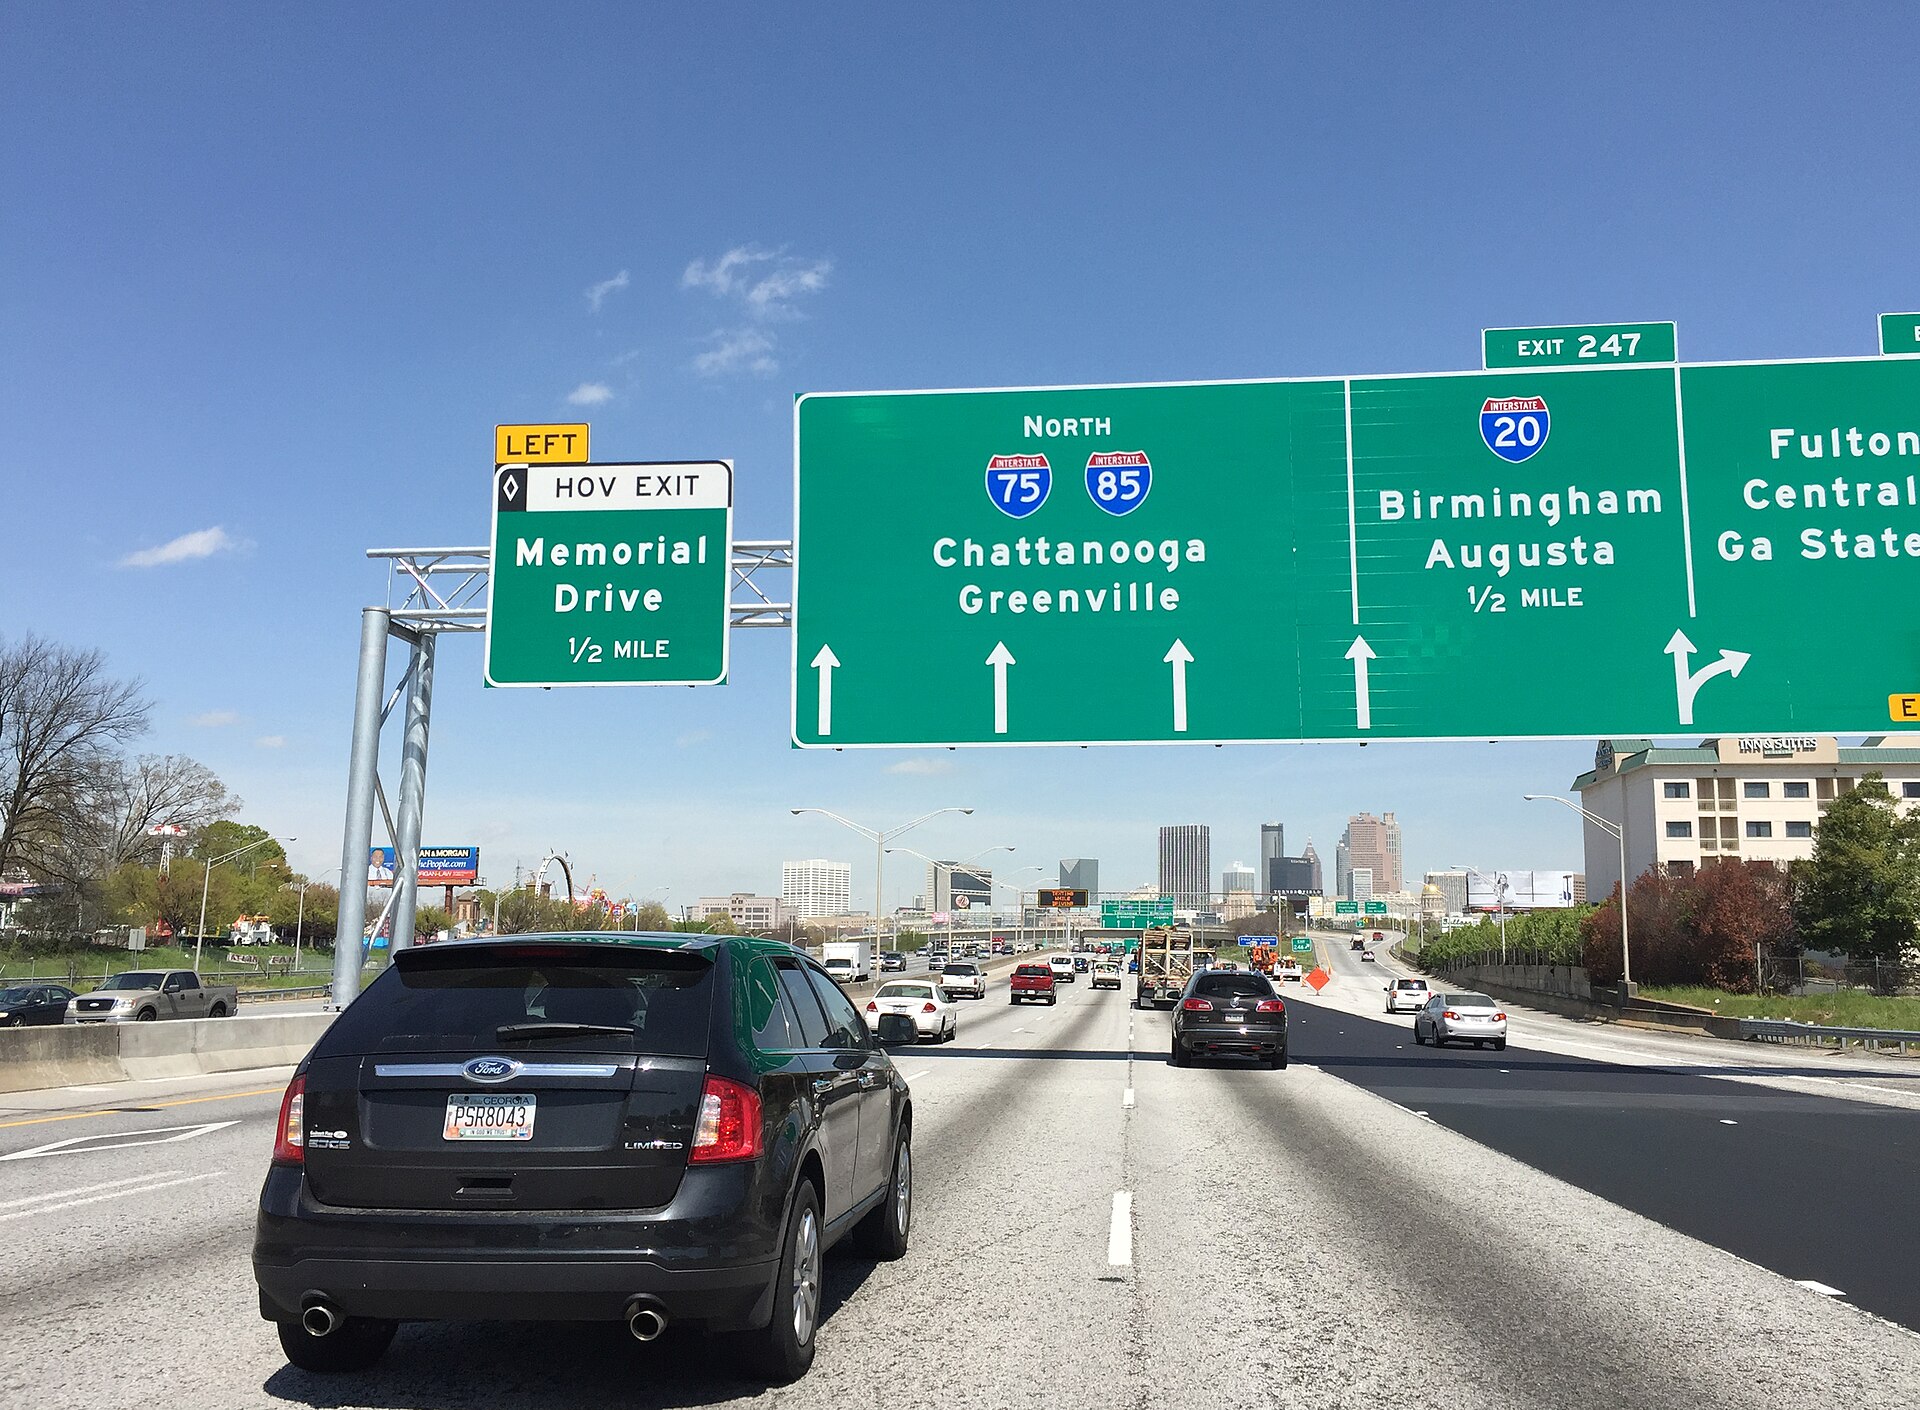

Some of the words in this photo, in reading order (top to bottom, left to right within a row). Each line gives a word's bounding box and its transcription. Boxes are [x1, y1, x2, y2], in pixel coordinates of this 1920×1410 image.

[1517, 338, 1565, 357] EXIT
[1577, 333, 1641, 358] 247
[1490, 400, 1539, 411] INTERSTATE
[1494, 415, 1540, 448] 20
[1769, 426, 1920, 460] Fulton
[506, 433, 577, 456] LEFT
[995, 458, 1041, 469] INTERSTATE
[1095, 454, 1141, 465] INTERSTATE
[555, 476, 617, 498] HOV
[636, 475, 700, 497] EXIT
[997, 473, 1041, 503] 75
[1097, 470, 1140, 501] 85
[1743, 475, 1917, 510] Central
[1379, 485, 1662, 527] Birmingham
[515, 535, 708, 567] Memorial
[933, 536, 1207, 573] Chattanooga
[1424, 535, 1615, 578] Augusta
[1717, 530, 1773, 562] Ga
[1800, 527, 1920, 560] State
[554, 582, 664, 613] Drive
[958, 581, 1180, 615] Greenville
[1520, 587, 1584, 608] MILE
[613, 639, 670, 659] MILE
[1739, 738, 1762, 750] INN
[1763, 738, 1774, 750] &
[1774, 737, 1818, 750] SUITES
[436, 849, 469, 857] MORGAN
[474, 1061, 504, 1075] Ford
[483, 1096, 530, 1105] GEORGIA
[454, 1106, 526, 1127] PSR8043
[624, 1141, 683, 1150] LIMITED
